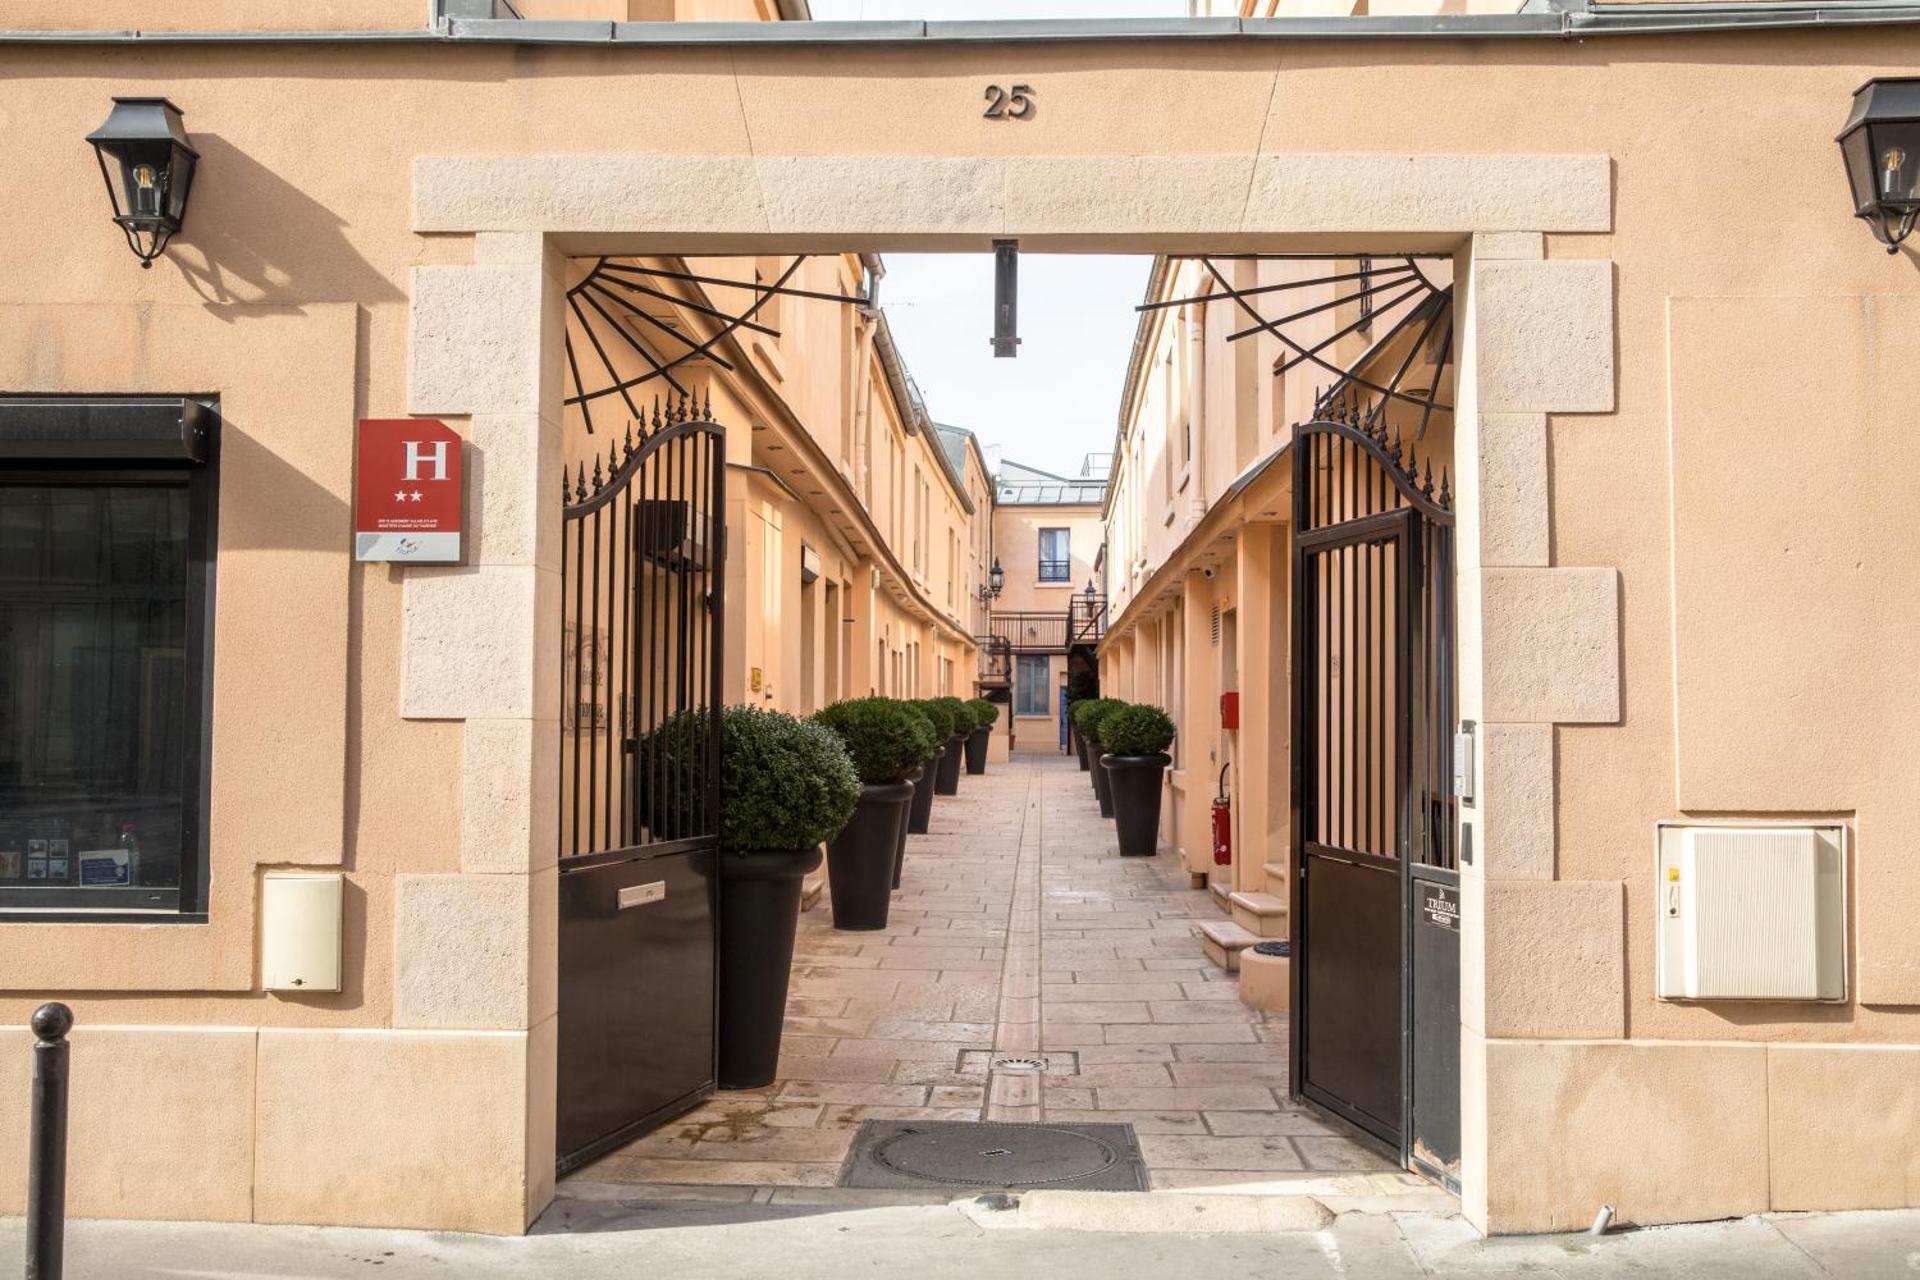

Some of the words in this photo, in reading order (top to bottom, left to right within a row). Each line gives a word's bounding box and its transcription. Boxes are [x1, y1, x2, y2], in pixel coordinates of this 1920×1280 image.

[983, 84, 1030, 118] 25
[401, 441, 452, 480] H
[1427, 897, 1456, 914] TRIUM
